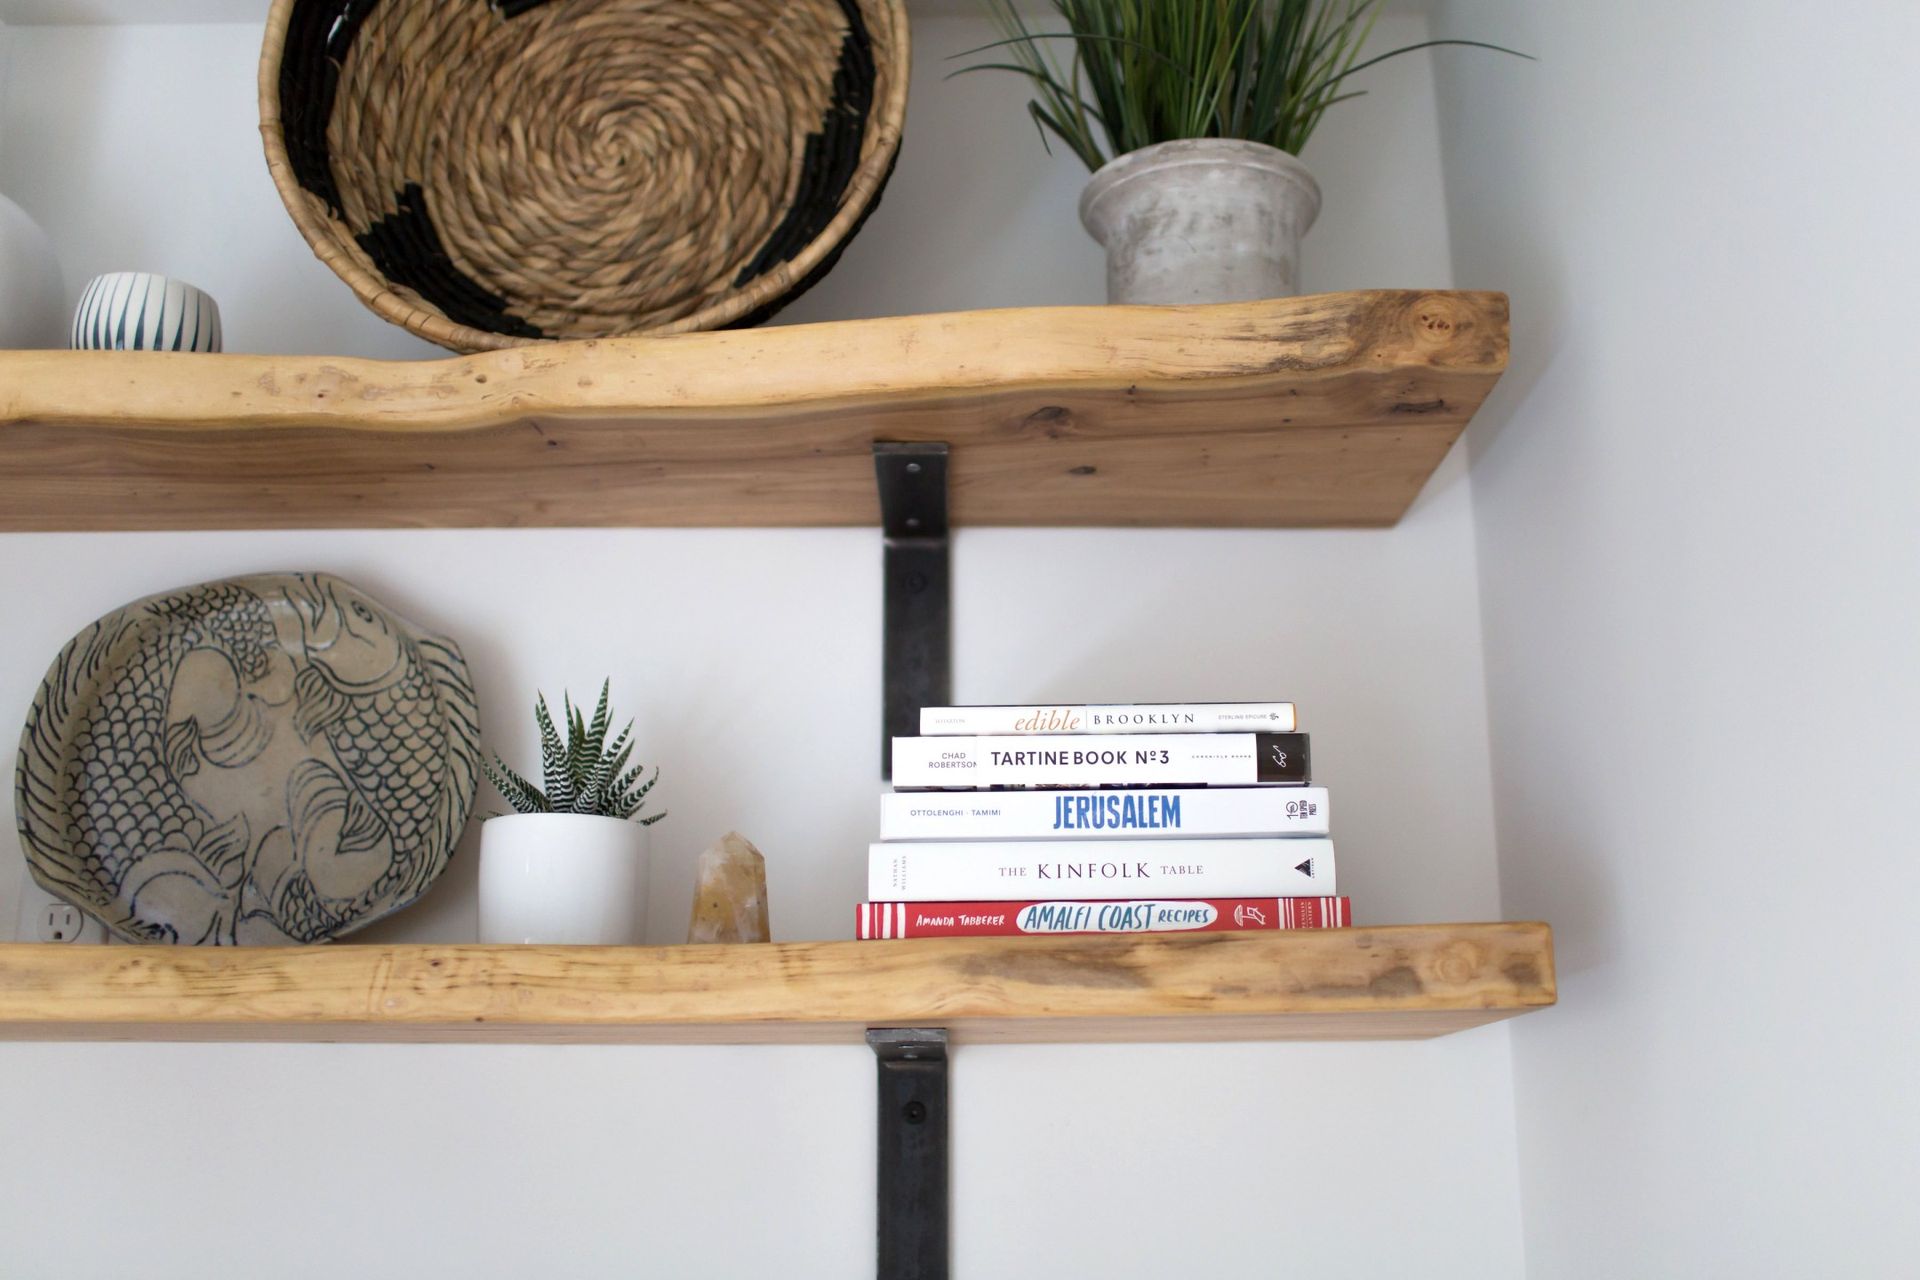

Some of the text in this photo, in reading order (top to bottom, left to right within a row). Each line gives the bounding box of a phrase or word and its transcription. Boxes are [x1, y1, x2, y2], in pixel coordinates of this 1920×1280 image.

[1014, 710, 1195, 731] edible BROOKLYN
[941, 752, 967, 760] CHAD
[990, 751, 1069, 766] TARTINE
[1073, 750, 1128, 765] BOOK
[910, 809, 964, 817] OTTOLENGHI
[1053, 795, 1181, 829] JERUSALEM
[998, 863, 1204, 879] THE KINFOLK TABLE
[1023, 904, 1209, 931] AMALFI COAST RECIPES
